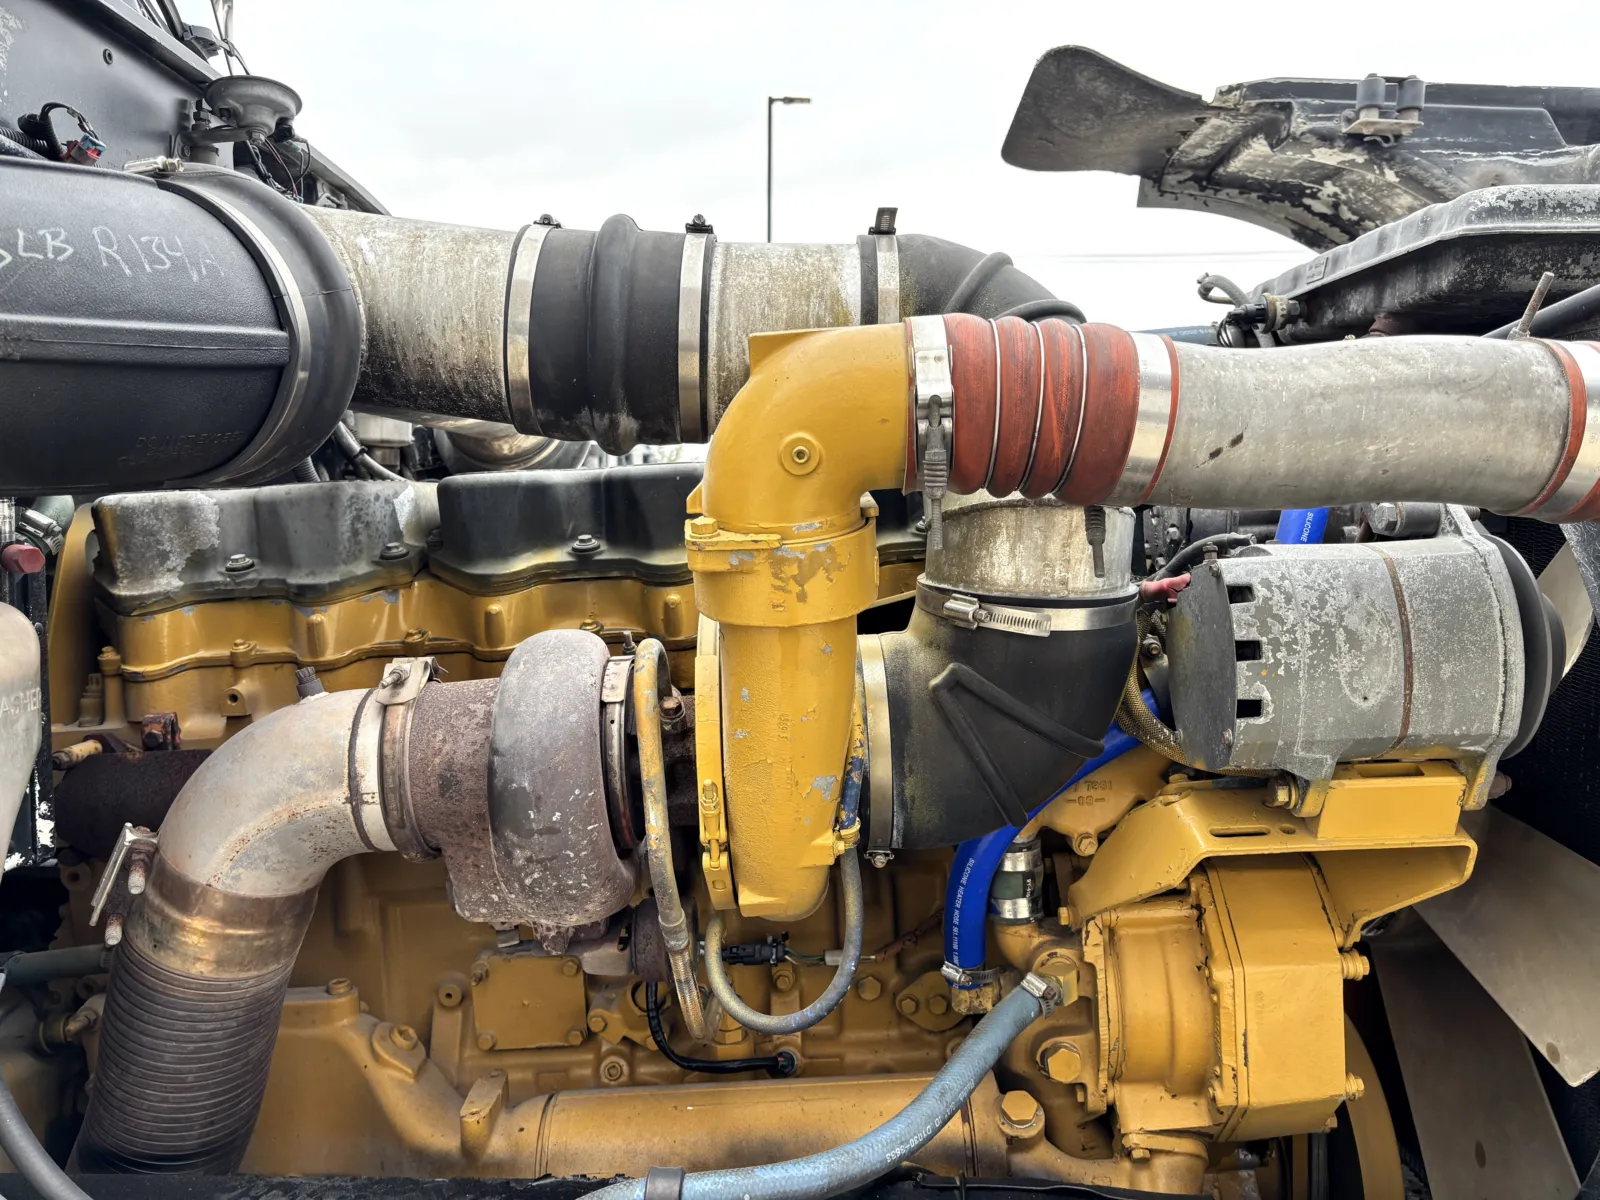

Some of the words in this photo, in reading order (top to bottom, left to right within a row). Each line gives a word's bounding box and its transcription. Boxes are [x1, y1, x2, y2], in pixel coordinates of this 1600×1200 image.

[1300, 511, 1314, 543] SILICONE
[960, 857, 975, 886] SILICONE
[954, 885, 965, 909] HEATER
